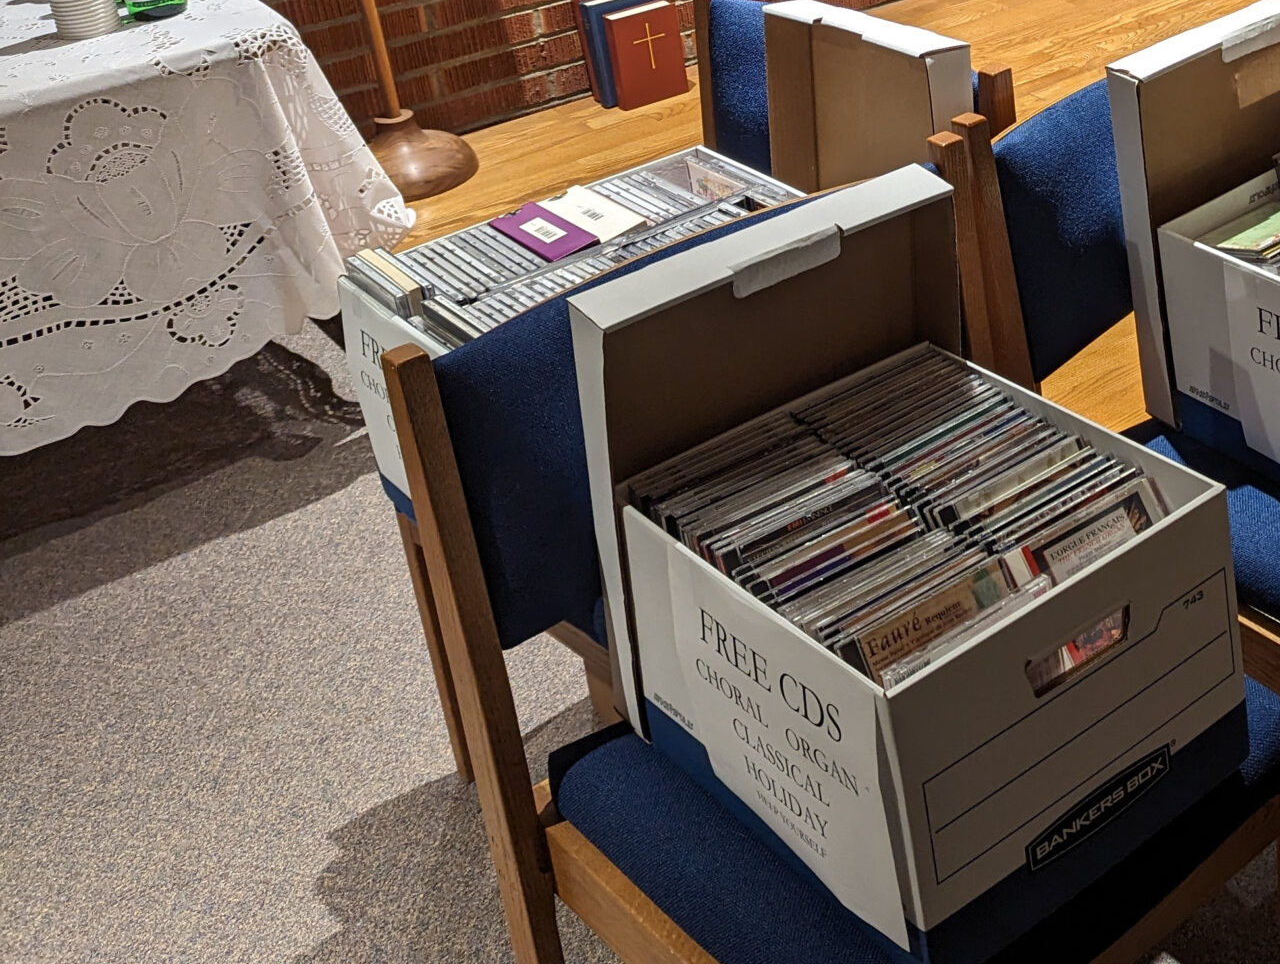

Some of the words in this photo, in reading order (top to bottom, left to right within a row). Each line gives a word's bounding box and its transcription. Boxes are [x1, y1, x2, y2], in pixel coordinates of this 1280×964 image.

[360, 329, 387, 370] FR
[360, 370, 390, 403] CHO
[1182, 590, 1205, 610] 743
[865, 611, 922, 658] Fauré
[699, 606, 771, 692] FREE
[780, 673, 842, 742] CDS
[696, 658, 768, 728] CHORAL
[785, 728, 858, 797] ORGAN
[733, 718, 830, 807] CLASSICAL
[744, 755, 828, 838] HOLIDAY
[1036, 787, 1124, 860] BANKERS
[1127, 757, 1164, 792] BOX
[780, 813, 828, 858] YOURSELF
